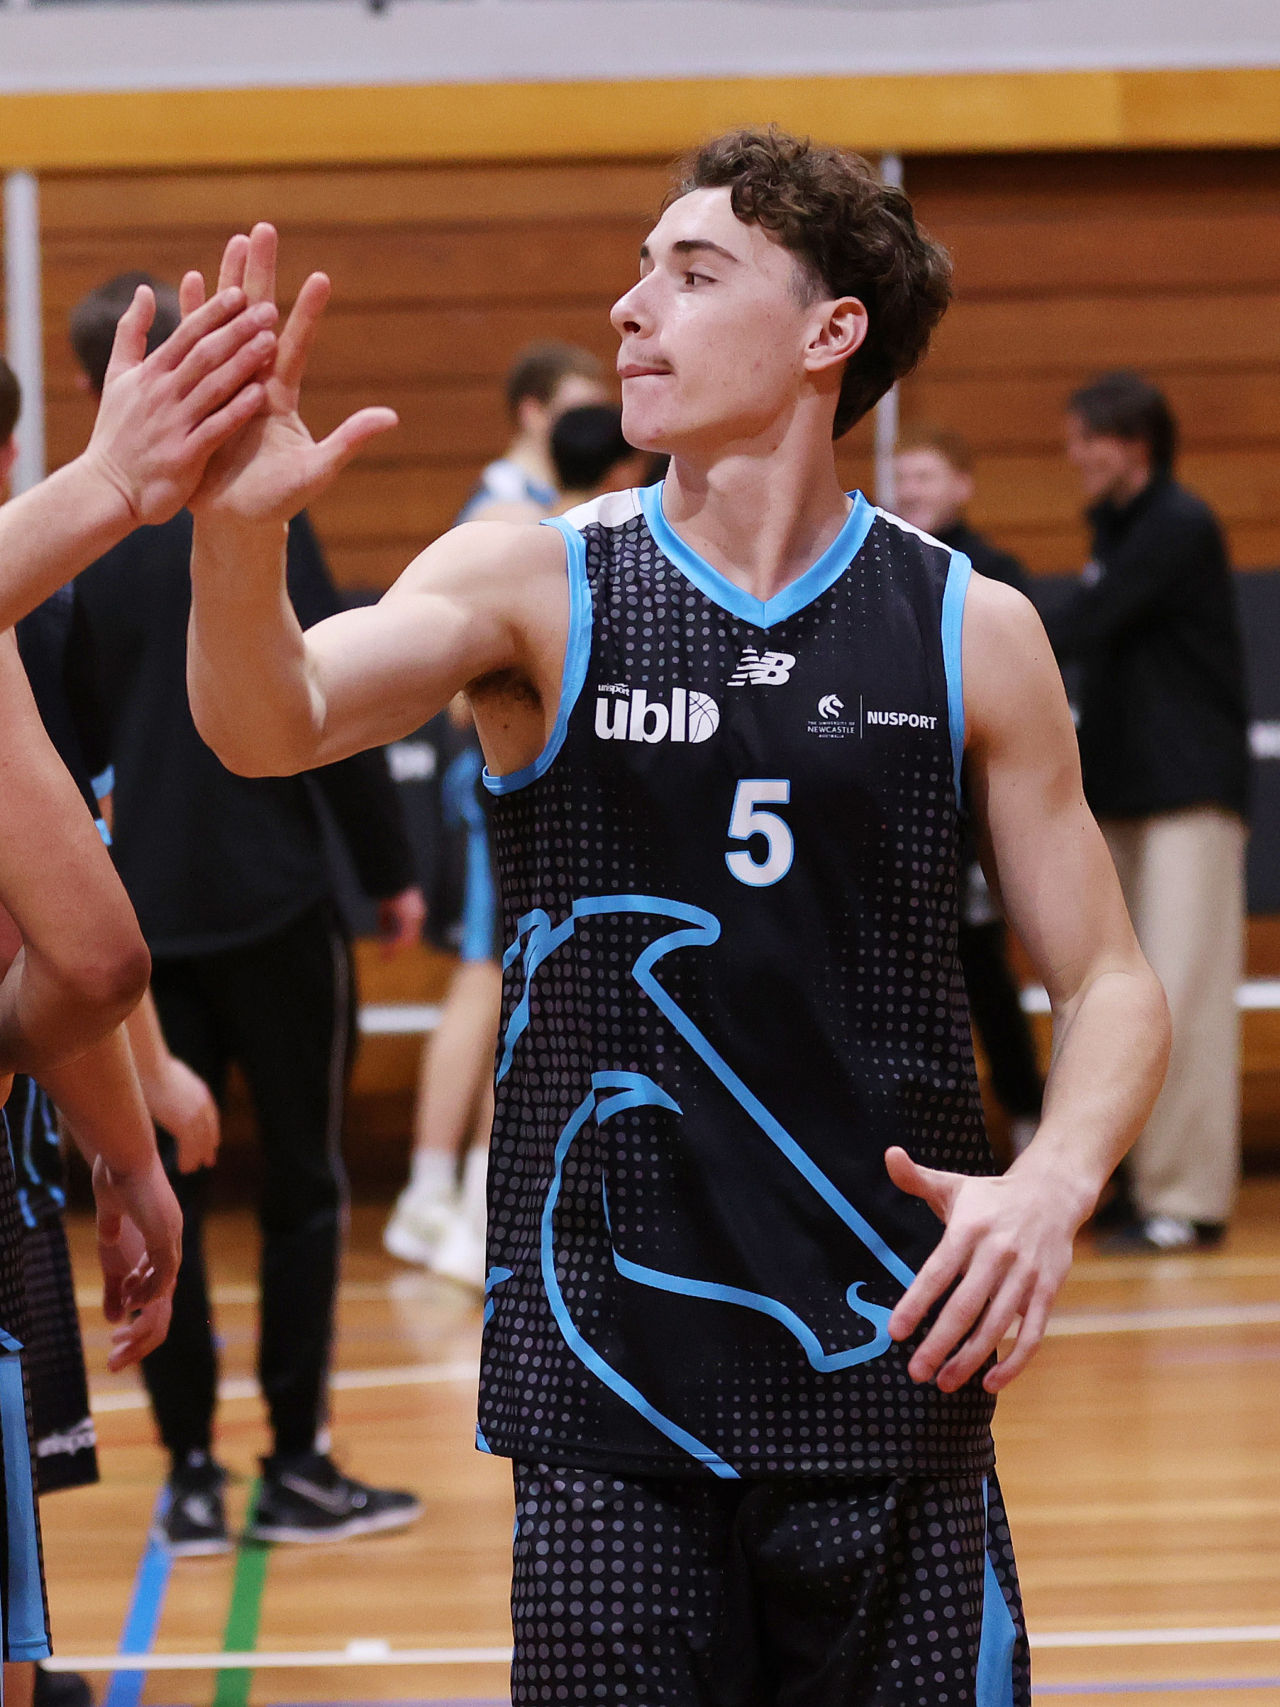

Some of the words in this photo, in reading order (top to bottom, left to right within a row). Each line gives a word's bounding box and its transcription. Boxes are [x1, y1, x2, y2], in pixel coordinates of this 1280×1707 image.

[807, 726, 855, 734] NEWCASTLE
[866, 711, 937, 730] NUSPORT
[725, 779, 794, 887] 5
